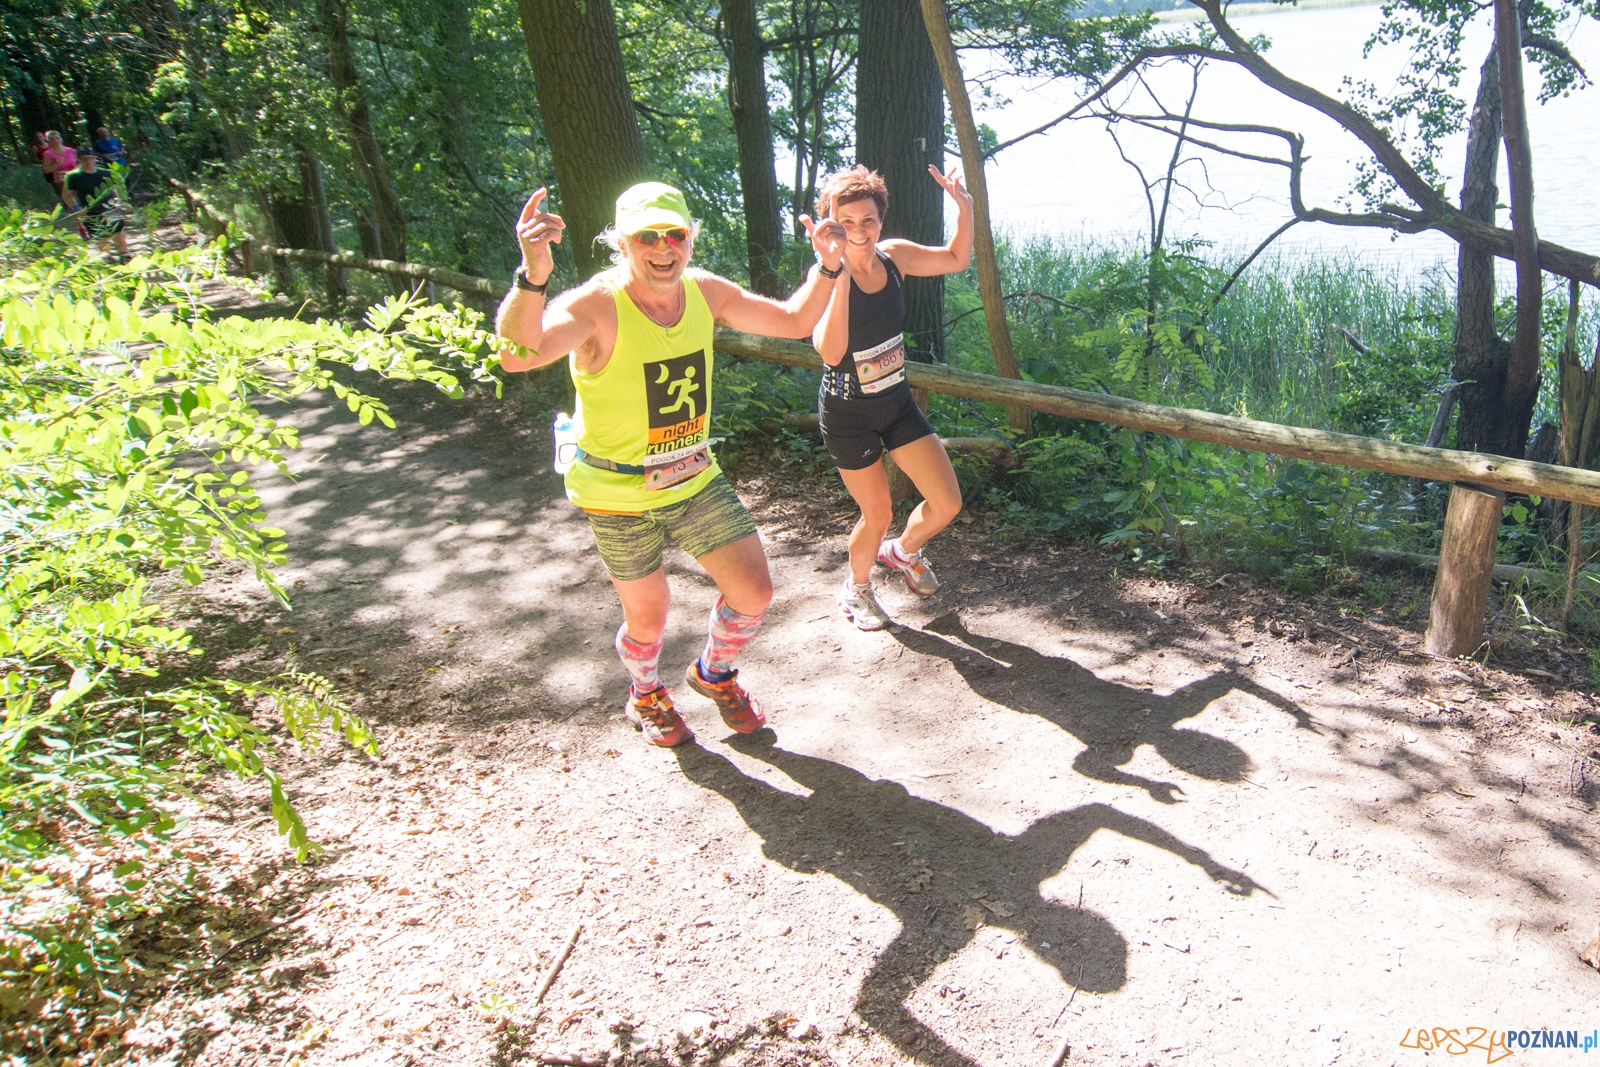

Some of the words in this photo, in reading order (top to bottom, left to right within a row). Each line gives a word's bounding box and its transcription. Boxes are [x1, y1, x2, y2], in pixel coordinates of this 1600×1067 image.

[877, 352, 896, 370] 186
[663, 418, 699, 438] night
[646, 429, 704, 455] runners
